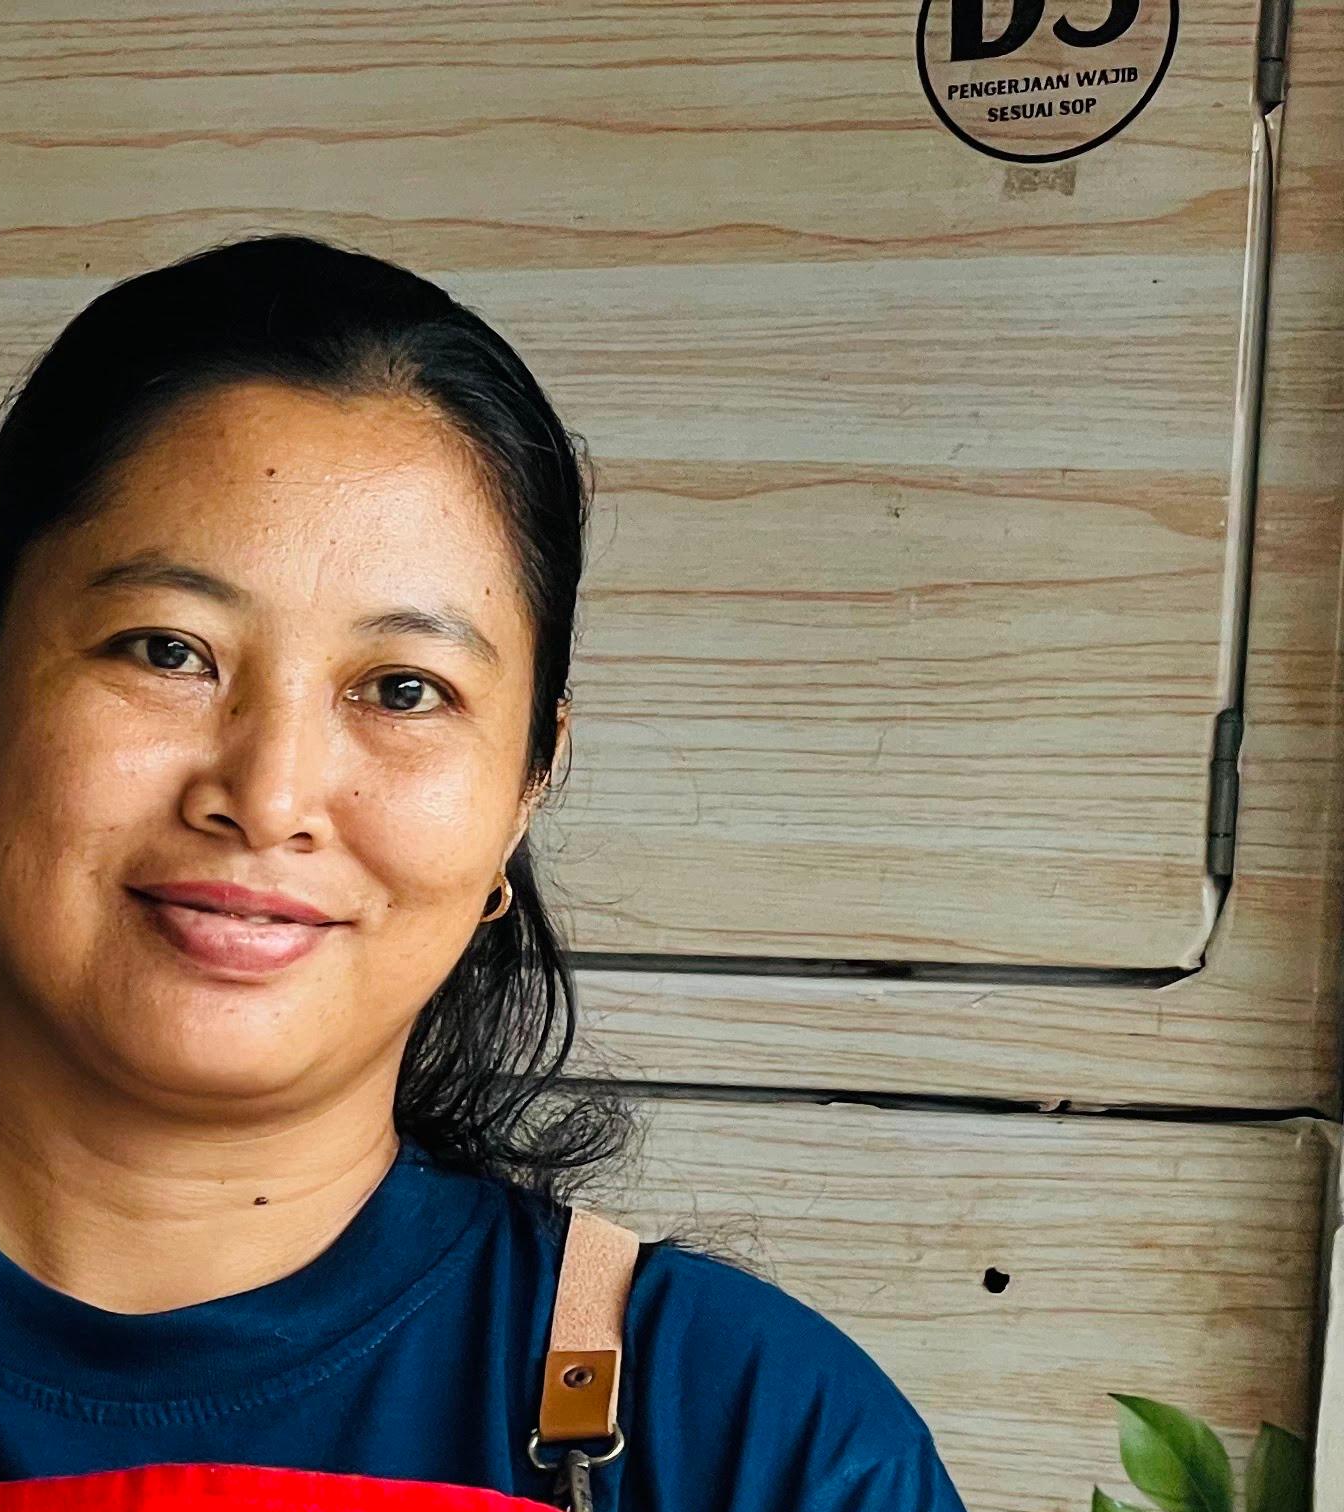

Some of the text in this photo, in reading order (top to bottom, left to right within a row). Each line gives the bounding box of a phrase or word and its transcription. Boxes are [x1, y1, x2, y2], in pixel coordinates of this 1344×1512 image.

[948, 67, 1138, 100] PENGERJAAN WAJIB
[987, 98, 1097, 122] SESUAI SOP
